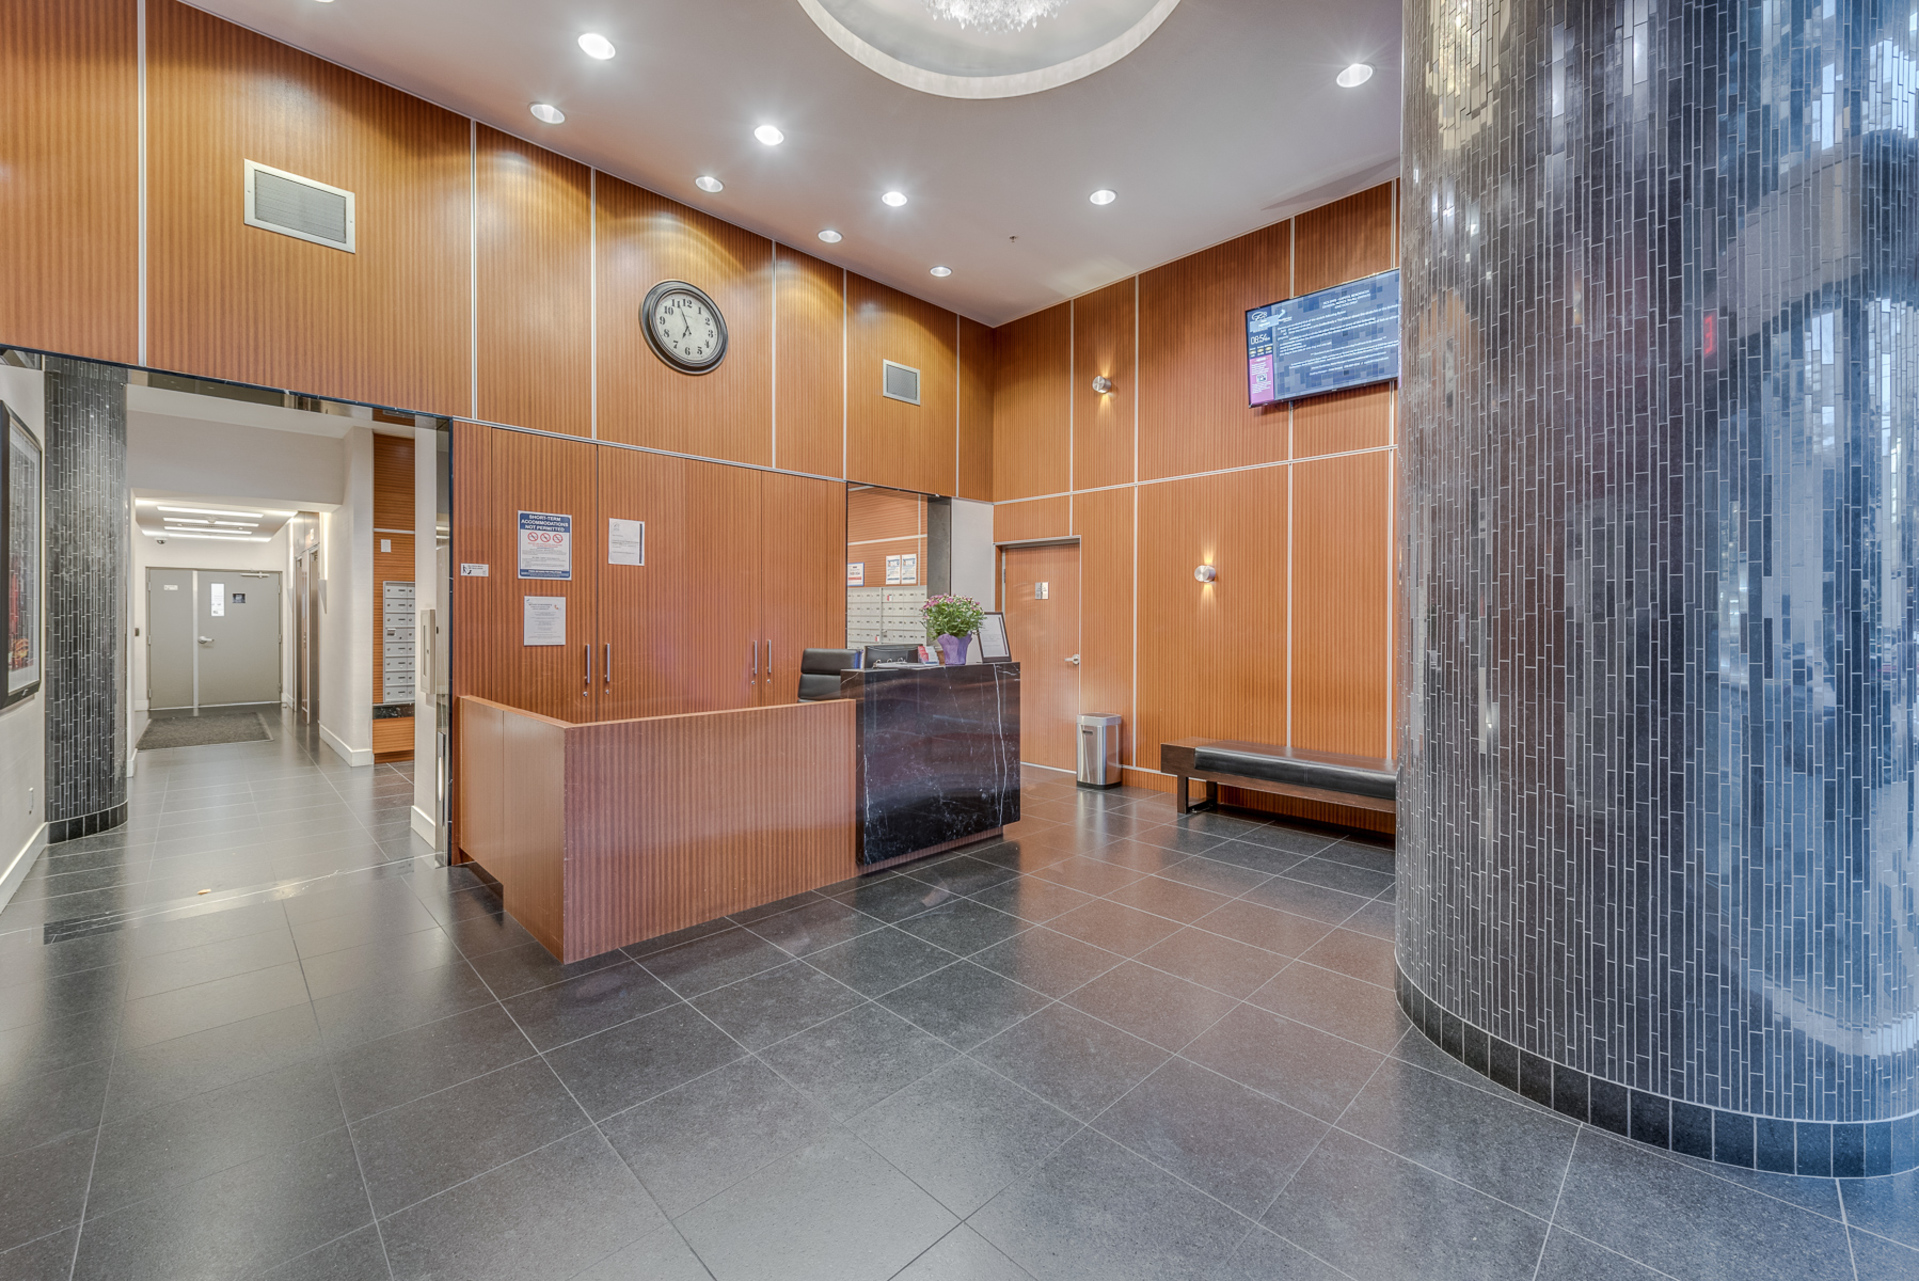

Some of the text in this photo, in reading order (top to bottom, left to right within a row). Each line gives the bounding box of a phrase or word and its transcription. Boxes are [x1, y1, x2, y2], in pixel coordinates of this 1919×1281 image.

[671, 299, 681, 308] 11
[682, 299, 692, 308] 12
[664, 306, 674, 315] 10
[698, 307, 702, 315] 1
[659, 316, 665, 325] 9
[705, 317, 710, 326] 2
[664, 329, 669, 338] 8
[708, 330, 713, 338] 3
[673, 340, 678, 349] 7
[705, 340, 709, 348] 4
[685, 347, 690, 355] 6
[697, 346, 702, 355] 5
[521, 519, 569, 527] ACCOMMODATIONS
